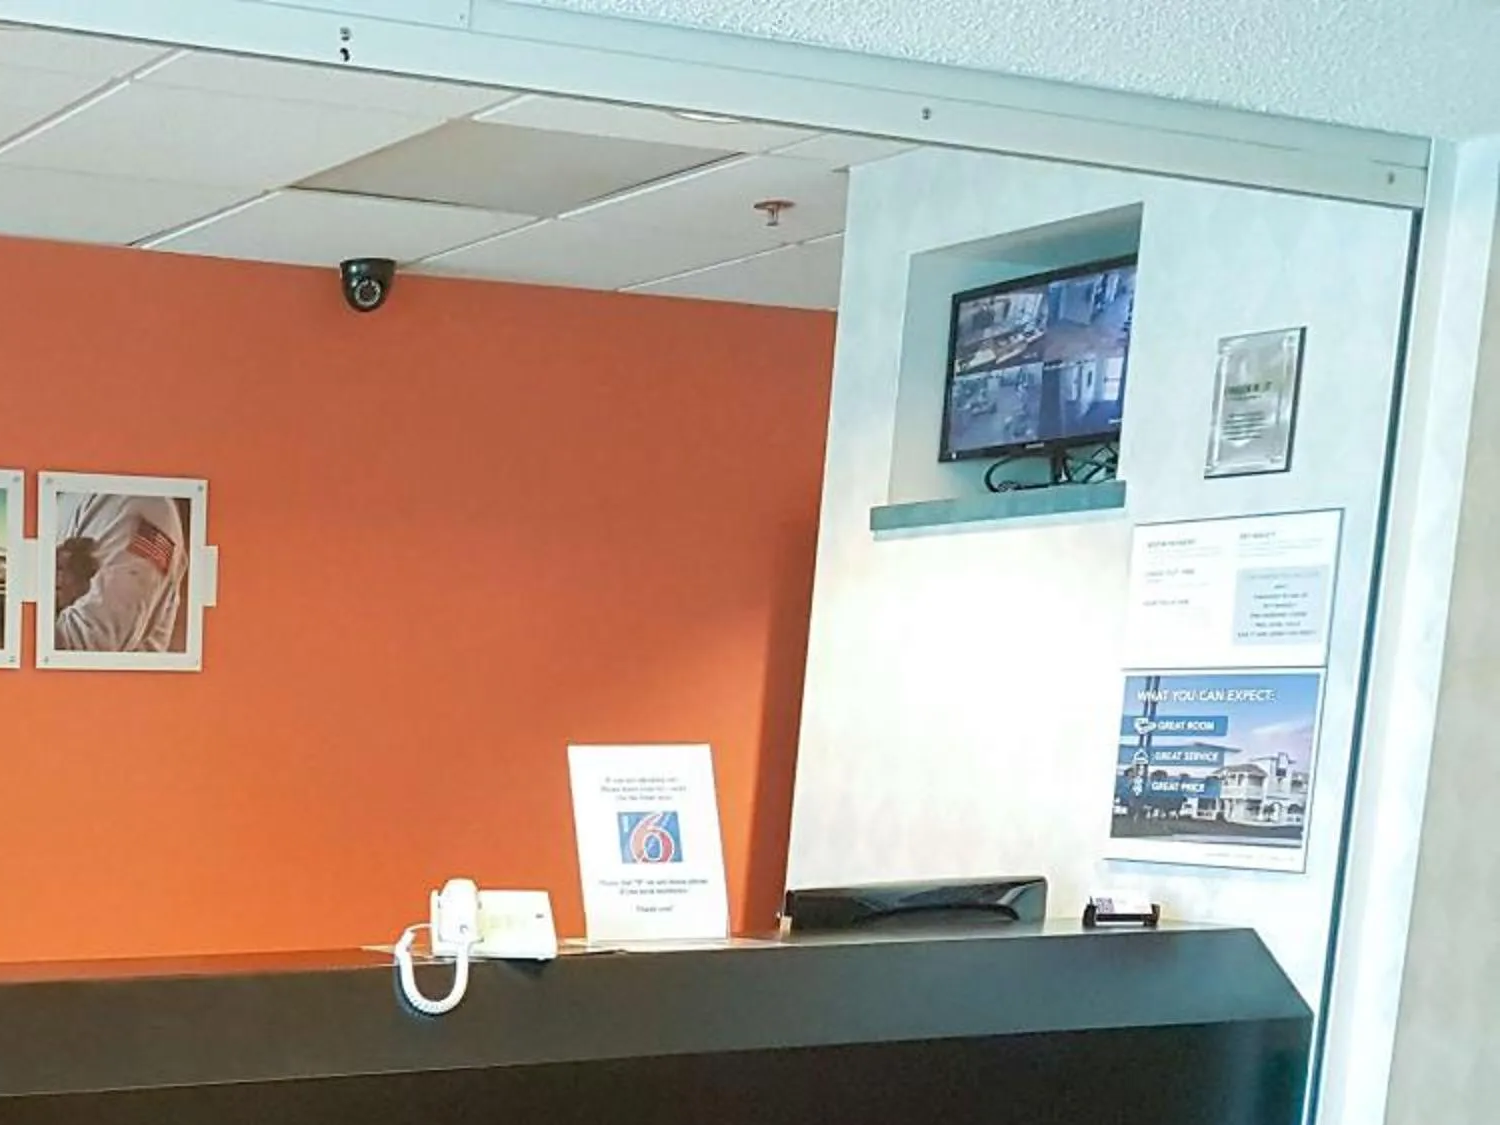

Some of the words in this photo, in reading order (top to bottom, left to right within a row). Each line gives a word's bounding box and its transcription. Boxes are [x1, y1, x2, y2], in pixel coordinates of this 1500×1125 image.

[1138, 687, 1169, 702] WHAT
[1171, 687, 1195, 702] YOU
[1199, 688, 1228, 702] CAN
[1158, 721, 1185, 731] GREAT
[1154, 750, 1182, 761] GREAT
[1184, 750, 1219, 762] SERVICE
[1151, 780, 1178, 792] GREAT
[1181, 781, 1206, 793] PRICE
[631, 812, 674, 865] 6
